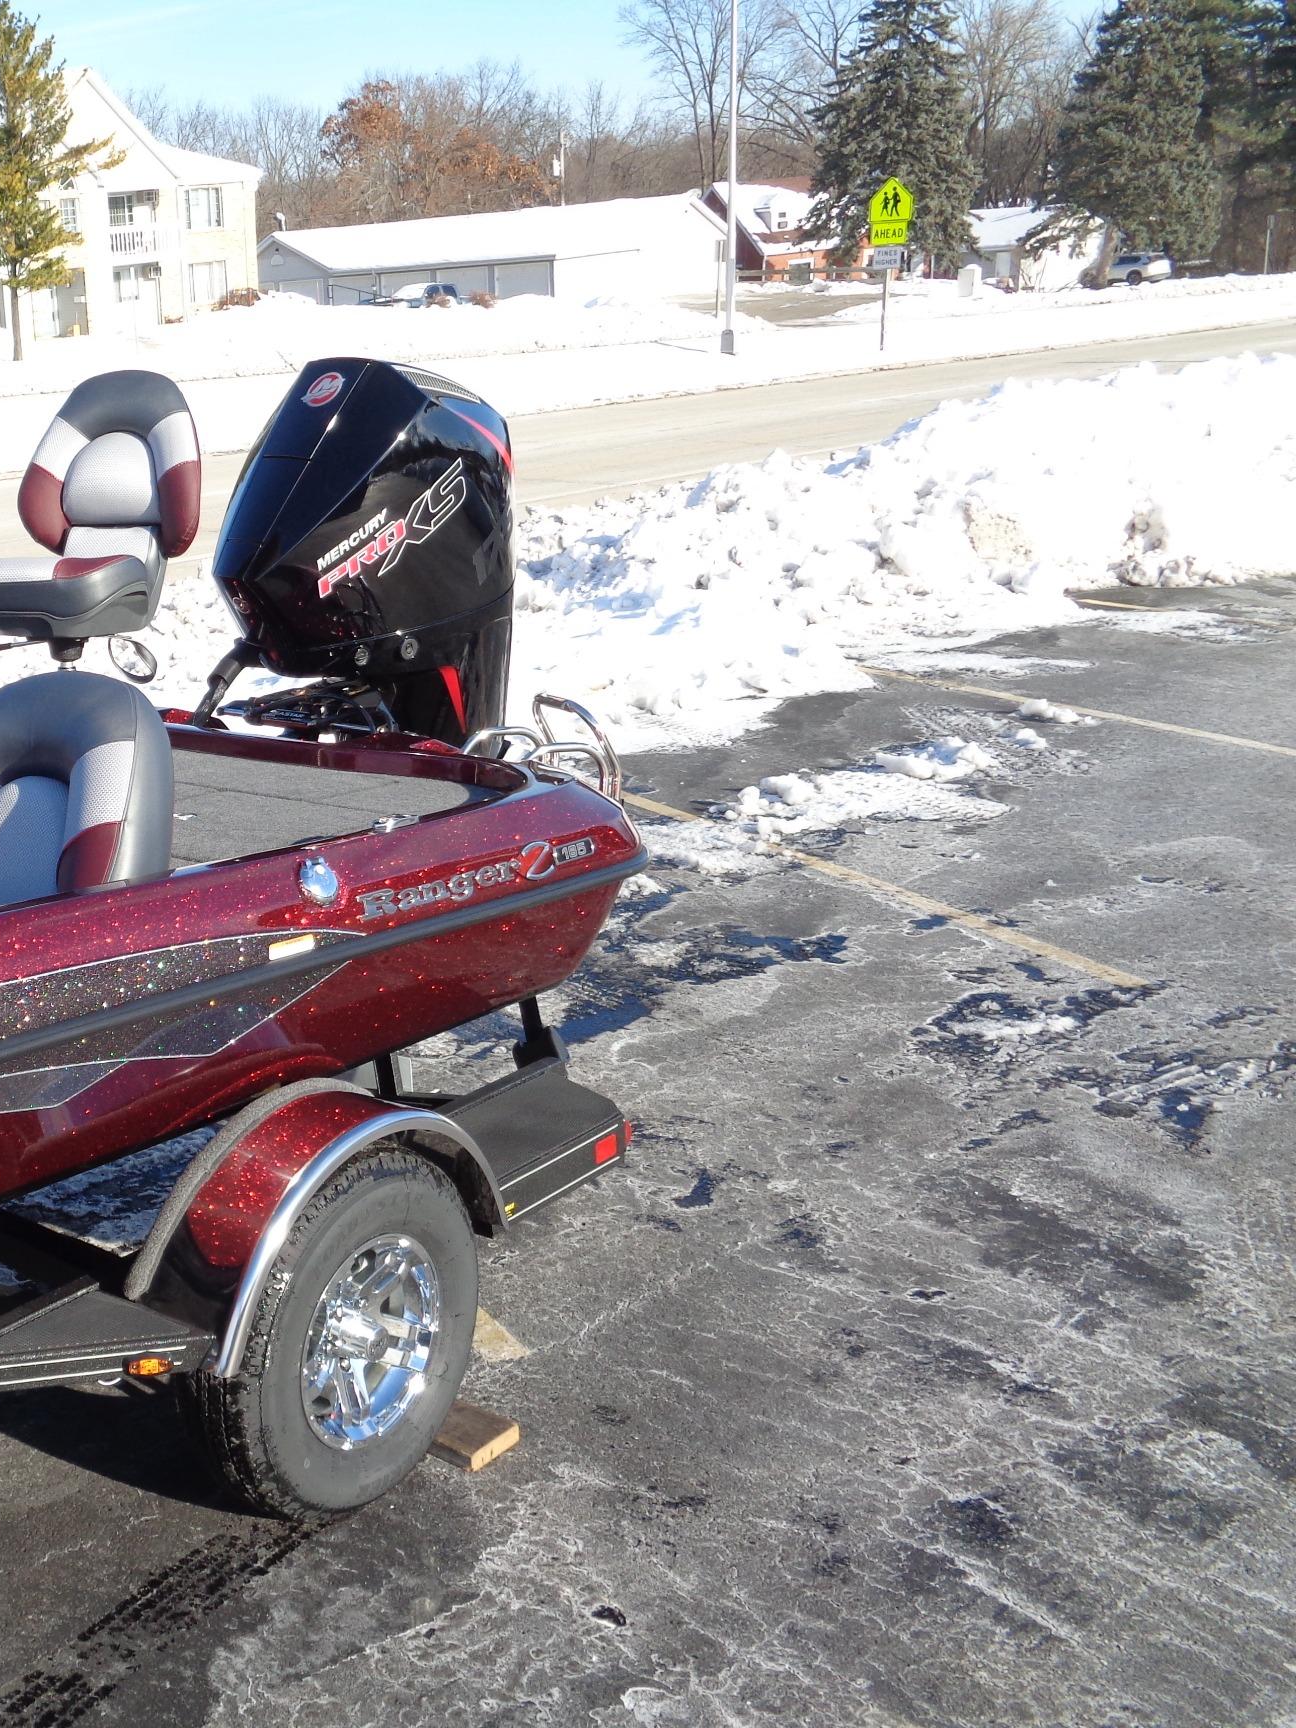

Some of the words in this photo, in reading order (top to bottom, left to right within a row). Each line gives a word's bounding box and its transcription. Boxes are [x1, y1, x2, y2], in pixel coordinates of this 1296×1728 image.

[873, 227, 904, 239] AHEAD
[875, 258, 898, 266] HIGHER
[877, 249, 898, 257] FINES
[316, 507, 389, 572] MERCURY
[317, 518, 407, 599] PRO
[356, 858, 522, 922] Ranger
